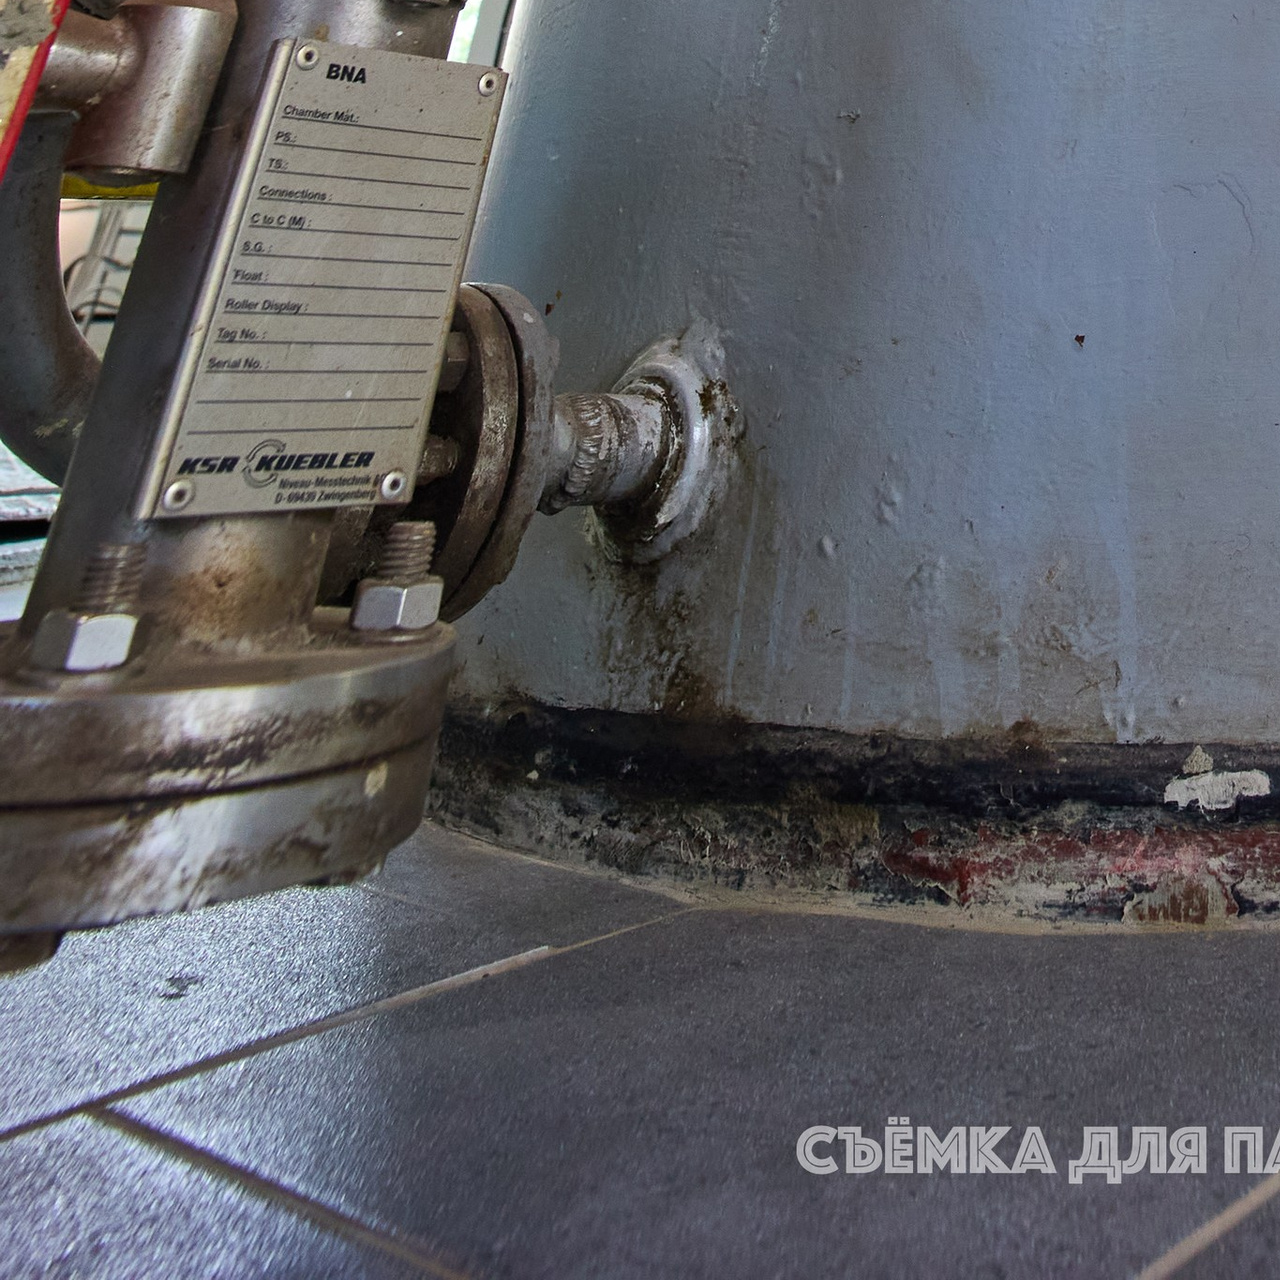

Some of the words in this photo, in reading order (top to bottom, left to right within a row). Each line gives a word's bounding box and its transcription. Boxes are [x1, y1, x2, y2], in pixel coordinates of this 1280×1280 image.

[326, 63, 367, 84] BNA
[283, 104, 331, 121] Chamber
[225, 297, 260, 311] Roller
[217, 327, 238, 342] Tag
[207, 356, 242, 370] Serial
[176, 455, 241, 475] KSR
[254, 450, 376, 472] KUEBLER
